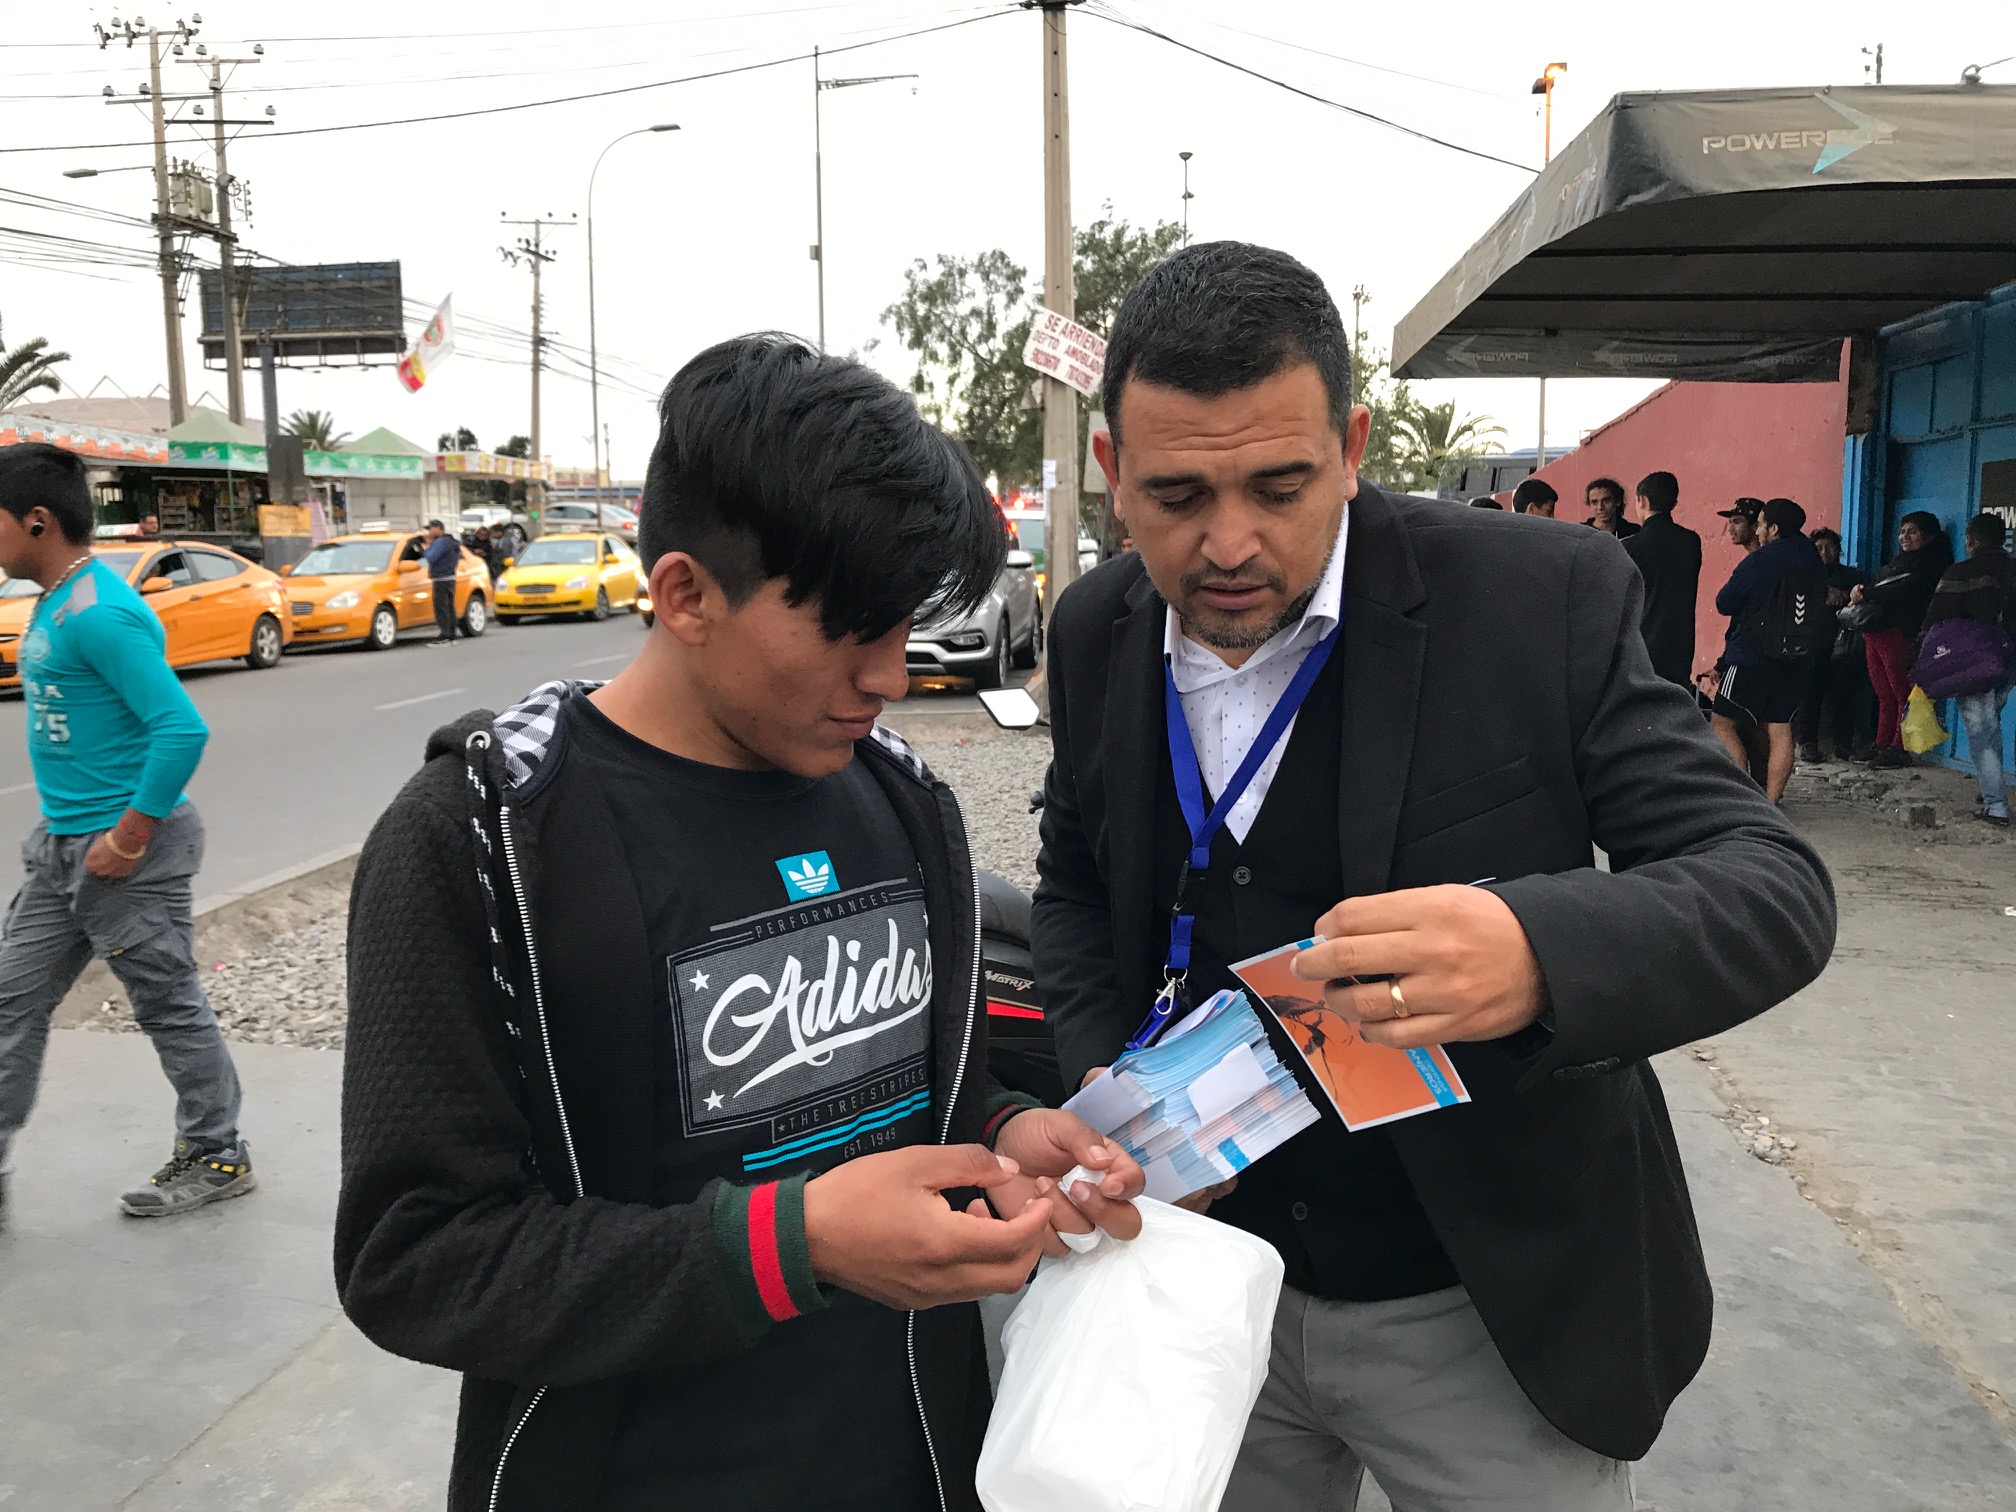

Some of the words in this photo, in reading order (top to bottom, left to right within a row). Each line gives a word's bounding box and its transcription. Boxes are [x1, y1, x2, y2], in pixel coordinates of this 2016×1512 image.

[1044, 314, 1061, 333] SE
[755, 891, 889, 938] PERFORMANCES
[985, 970, 1035, 991] MATRIX
[703, 917, 932, 1080] Adidas
[1408, 1048, 1443, 1095] ANJEROS
[788, 1109, 820, 1130] THE
[870, 1127, 896, 1148] 1949
